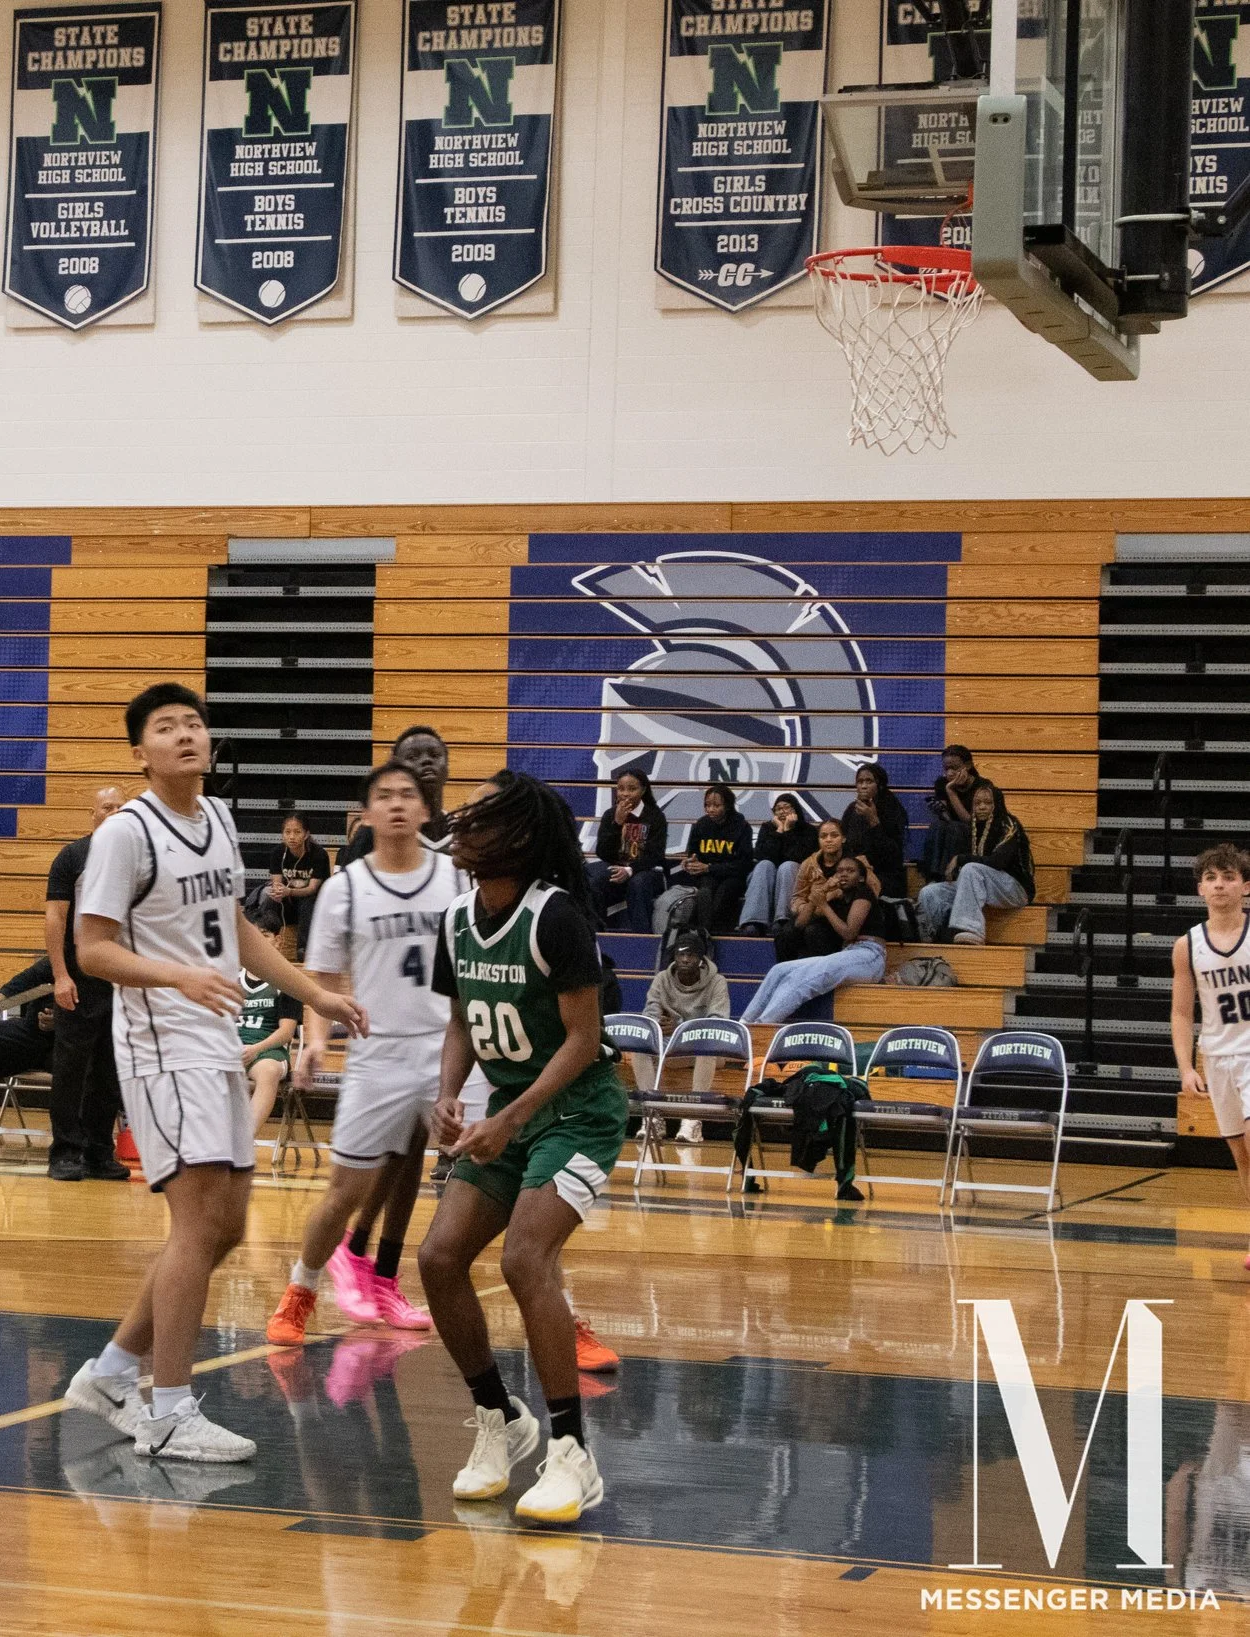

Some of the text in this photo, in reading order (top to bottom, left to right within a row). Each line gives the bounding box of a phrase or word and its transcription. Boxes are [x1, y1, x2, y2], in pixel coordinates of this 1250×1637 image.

[446, 2, 516, 25] STATE
[246, 15, 313, 37] STATE
[680, 9, 814, 37] CHAMPIONS
[54, 25, 119, 48] STATE
[417, 25, 544, 52] CHAMPIONS
[218, 36, 340, 63] CHAMPIONS
[26, 47, 145, 72] CHAMPIONS
[705, 41, 784, 116] N
[442, 56, 516, 128] N
[50, 76, 118, 145] N
[242, 67, 313, 137] N
[1191, 97, 1244, 115] HVIEW
[697, 120, 787, 138] NORTHVIEW
[917, 112, 969, 129] NORTH
[234, 142, 317, 159] NORTHVIEW
[434, 133, 519, 151] NORTHVIEW
[692, 138, 791, 157] HIGH SCHOOL
[43, 151, 122, 167] NORTHVIEW
[230, 159, 321, 177] HIGH SCHOOL
[429, 151, 524, 169] HIGH SCHOOL
[1191, 155, 1217, 173] YS
[38, 167, 126, 184] HIGH SCHOOL
[713, 175, 766, 193] GIRLS
[1190, 176, 1228, 195] NIS
[253, 194, 295, 212] BOYS
[454, 187, 497, 204] BOYS
[670, 193, 808, 215] CROSS COUNTRY
[57, 202, 104, 219] GIRLS
[444, 205, 506, 224] TENNIS
[30, 219, 129, 238] VOLLEYBALL
[244, 213, 304, 231] TENNIS
[717, 235, 759, 253] 2013
[942, 226, 973, 245] 201
[252, 251, 294, 269] 2008
[451, 243, 495, 263] 2009
[58, 257, 99, 275] 2008
[707, 758, 740, 782] N
[176, 868, 234, 906] TITANS
[202, 908, 224, 958] 5
[400, 945, 427, 987] 4
[457, 959, 527, 984] CLARKSTON
[1201, 964, 1250, 990] TITAN
[244, 998, 275, 1008] RKSTON
[1217, 990, 1250, 1026] 20
[467, 1000, 533, 1062] 20
[605, 1024, 650, 1040] RTHVIEW
[681, 1028, 739, 1045] NORTHVIEW
[784, 1033, 843, 1050] NORTHVIEW
[887, 1038, 947, 1056] NORTHVIEW
[992, 1042, 1052, 1060] NORTHVIEW
[873, 1105, 911, 1115] TITANS
[982, 1111, 1020, 1121] TITANS
